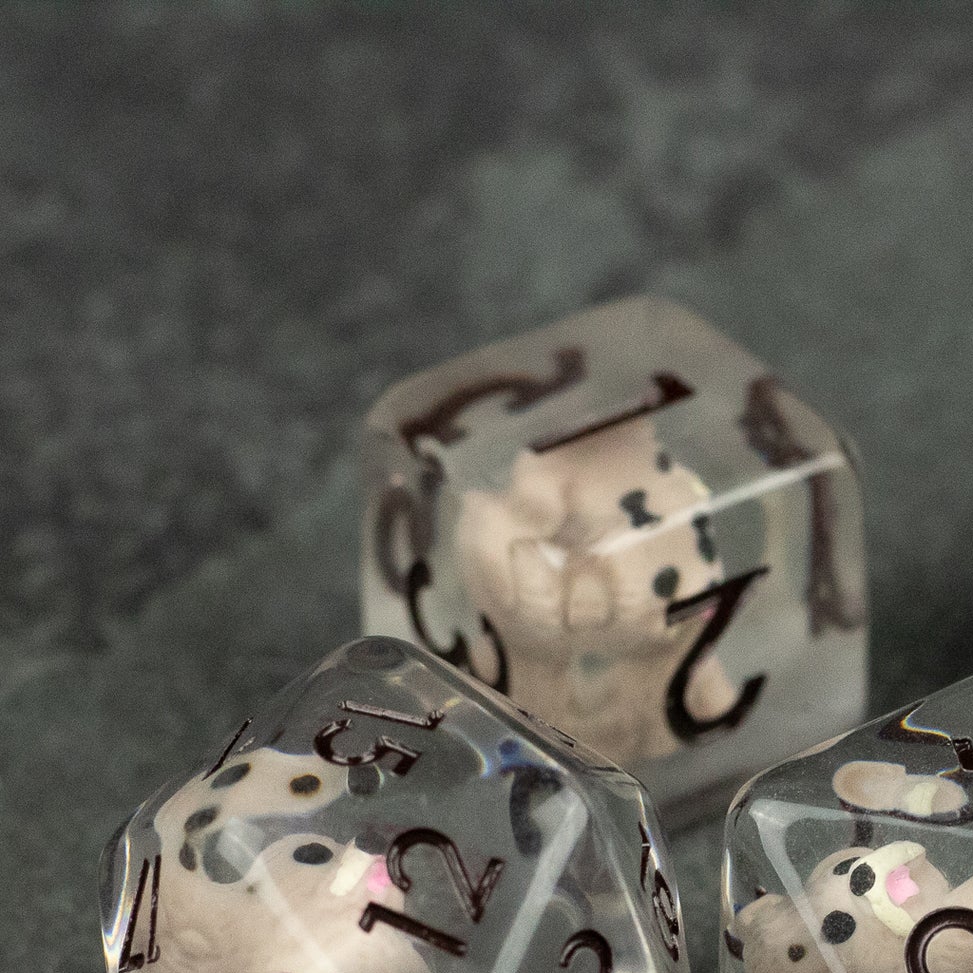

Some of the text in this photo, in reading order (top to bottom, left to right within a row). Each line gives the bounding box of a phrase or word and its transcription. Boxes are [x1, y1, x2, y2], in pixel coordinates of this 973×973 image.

[666, 565, 771, 746] 2
[312, 699, 446, 778] 15
[358, 827, 507, 959] 12
